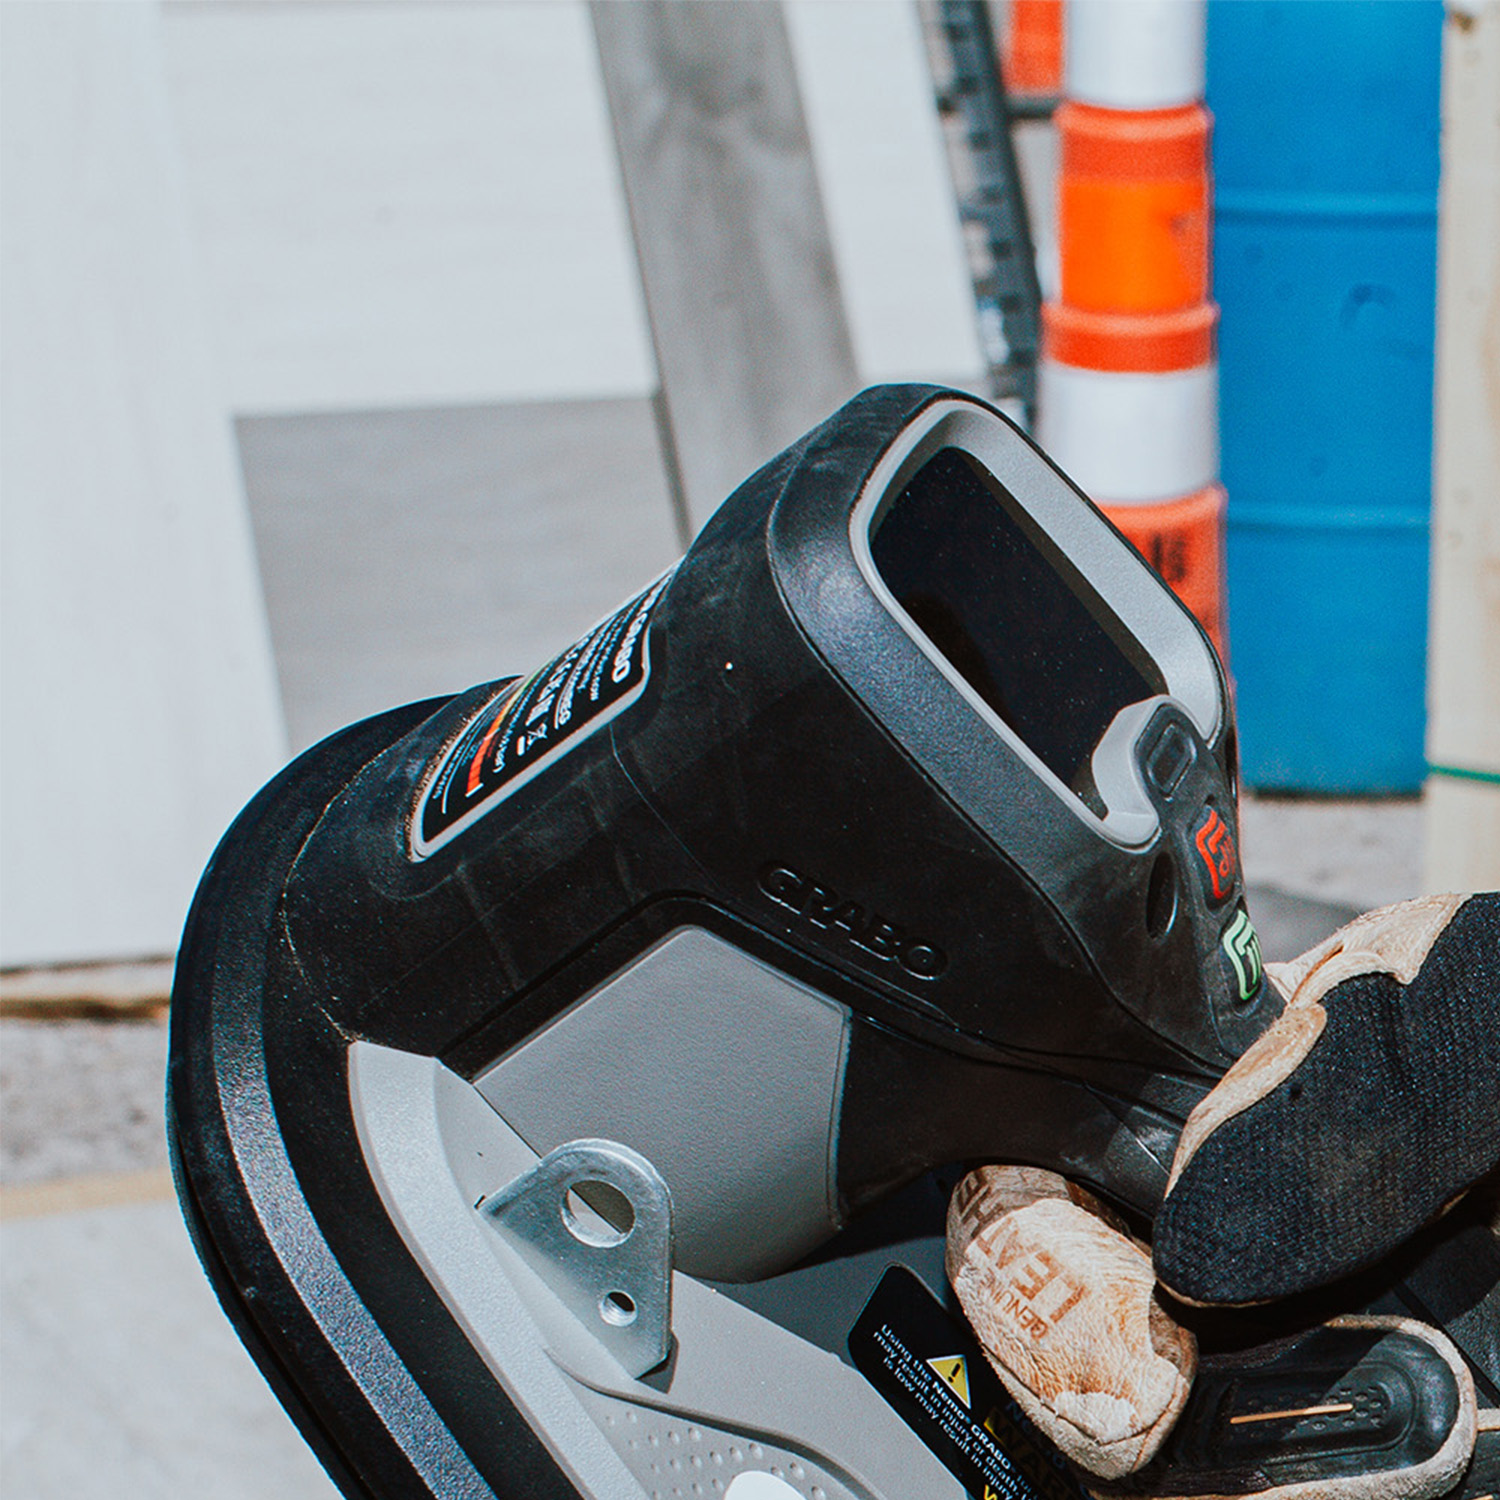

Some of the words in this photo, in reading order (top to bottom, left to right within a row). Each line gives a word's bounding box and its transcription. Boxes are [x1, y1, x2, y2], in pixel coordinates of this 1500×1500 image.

[757, 861, 949, 982] GRABO
[872, 1330, 898, 1359] may
[897, 1357, 930, 1394] result
[929, 1392, 942, 1408] in
[941, 1405, 973, 1443] injury
[971, 1440, 985, 1455] or
[880, 1323, 913, 1362] Using
[912, 1359, 932, 1382] the
[882, 1355, 893, 1370] is
[893, 1366, 916, 1392] low
[914, 1391, 940, 1419] may
[938, 1418, 970, 1454] result
[969, 1452, 982, 1467] in
[982, 1465, 1013, 1500] injury
